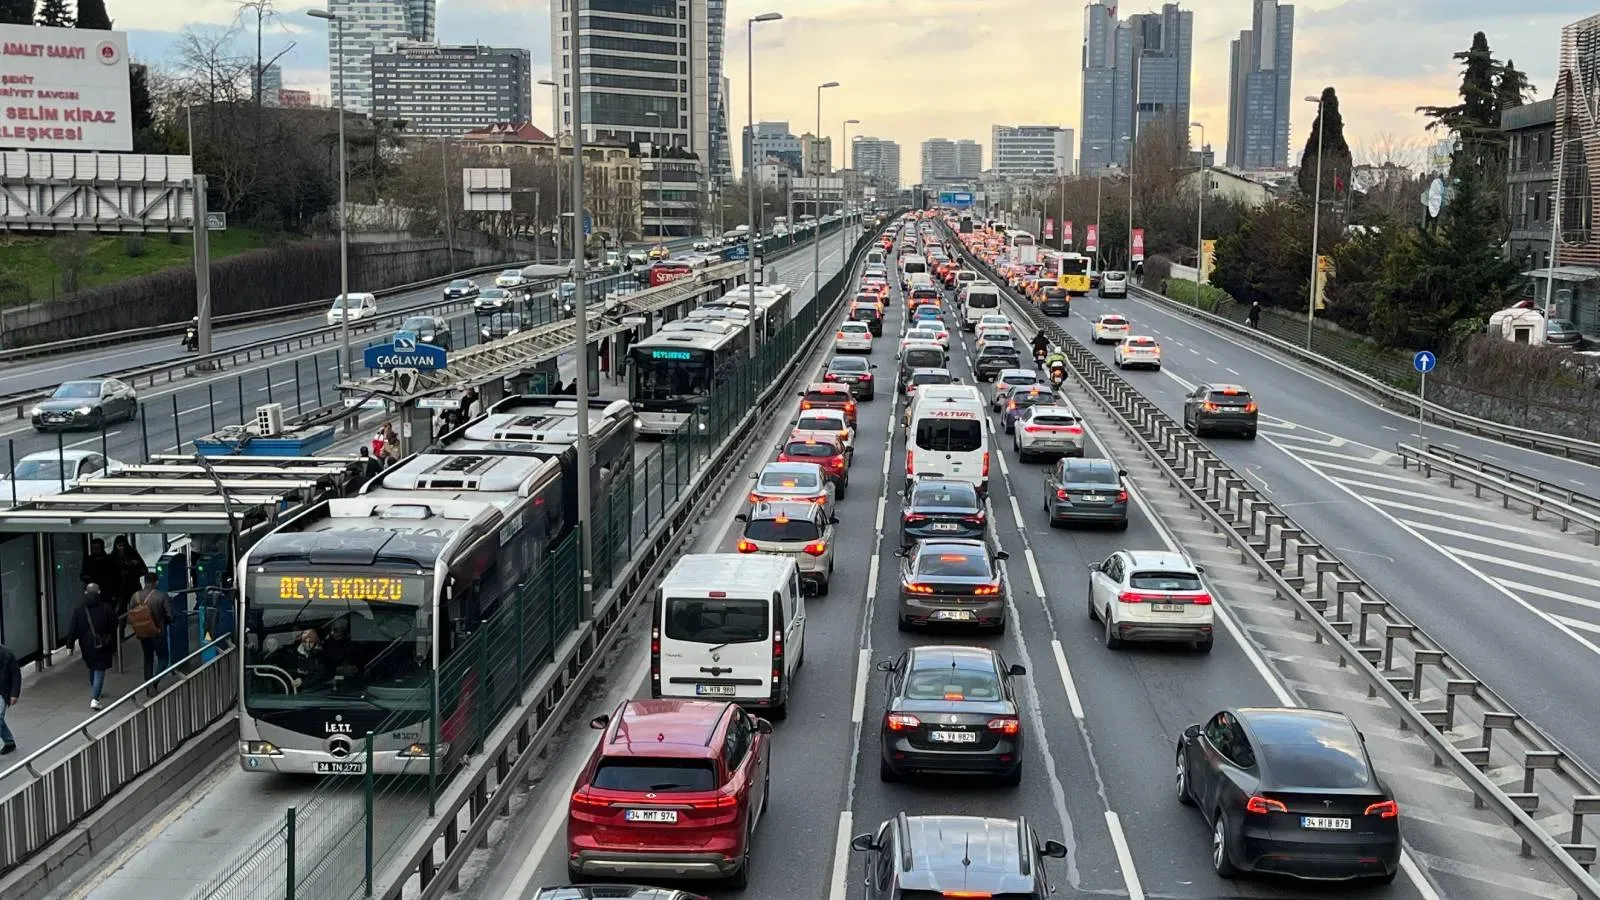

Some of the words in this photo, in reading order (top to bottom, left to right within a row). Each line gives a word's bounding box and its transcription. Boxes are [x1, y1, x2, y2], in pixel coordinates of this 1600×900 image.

[3, 43, 44, 57] ADALET
[47, 46, 85, 59] SARAYI
[2, 74, 34, 85] ŞEHİT
[37, 90, 79, 100] SAVCISI
[6, 105, 58, 121] SELİM
[64, 107, 116, 123] KİRAZ
[0, 126, 82, 142] LEŞKESİ
[376, 354, 434, 367] ÇAĞLAYAN
[319, 763, 329, 772] 34
[332, 763, 343, 772] TN
[630, 811, 640, 820] 34
[643, 811, 657, 819] MMT
[660, 812, 676, 821] 974
[1306, 818, 1316, 827] 34
